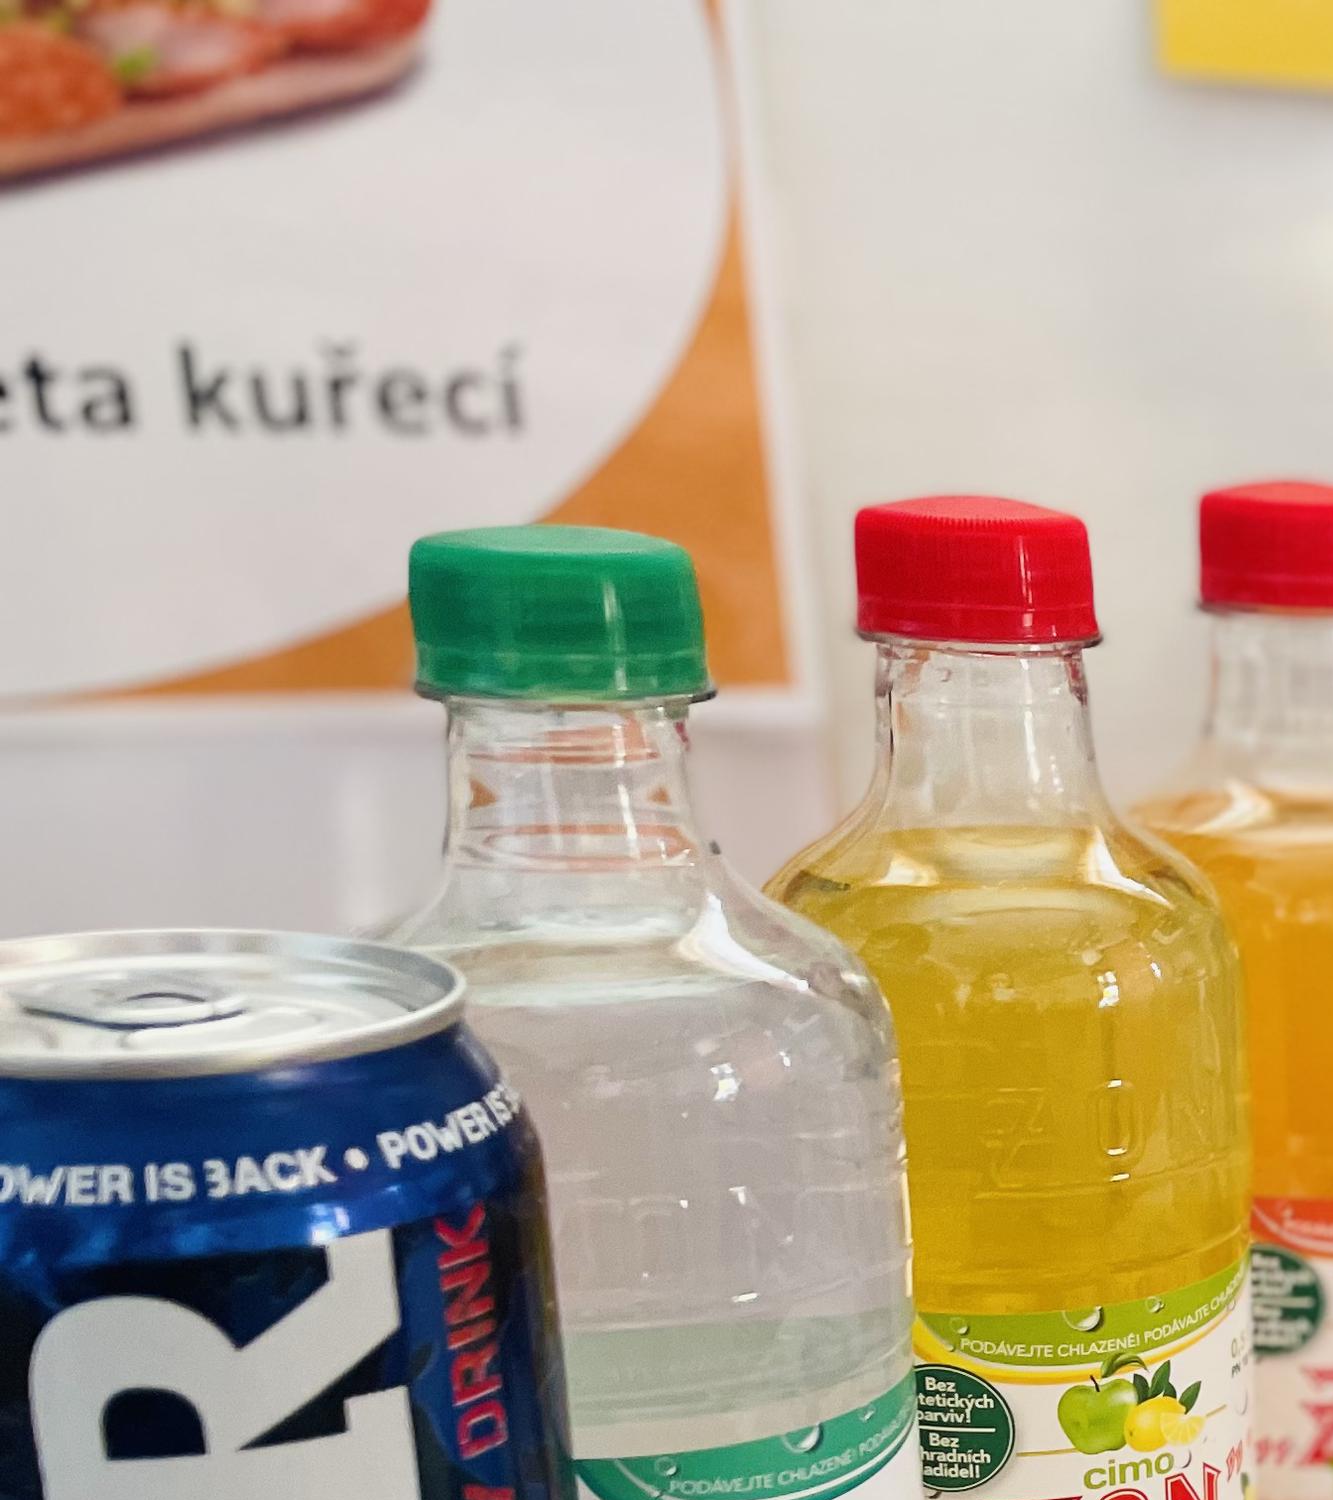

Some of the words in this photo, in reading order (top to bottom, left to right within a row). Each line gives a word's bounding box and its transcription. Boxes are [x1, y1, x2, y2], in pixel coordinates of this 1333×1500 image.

[178, 340, 523, 436] kuřecí
[377, 1101, 488, 1169] POWER
[144, 1162, 196, 1202] IS
[435, 1202, 511, 1460] DRINK
[925, 1376, 956, 1392] Bez
[918, 1393, 994, 1411] tetických
[928, 1432, 960, 1448] Bez
[920, 1446, 991, 1464] hradních
[923, 1463, 980, 1479] adidel!
[1083, 1452, 1175, 1490] cimo
